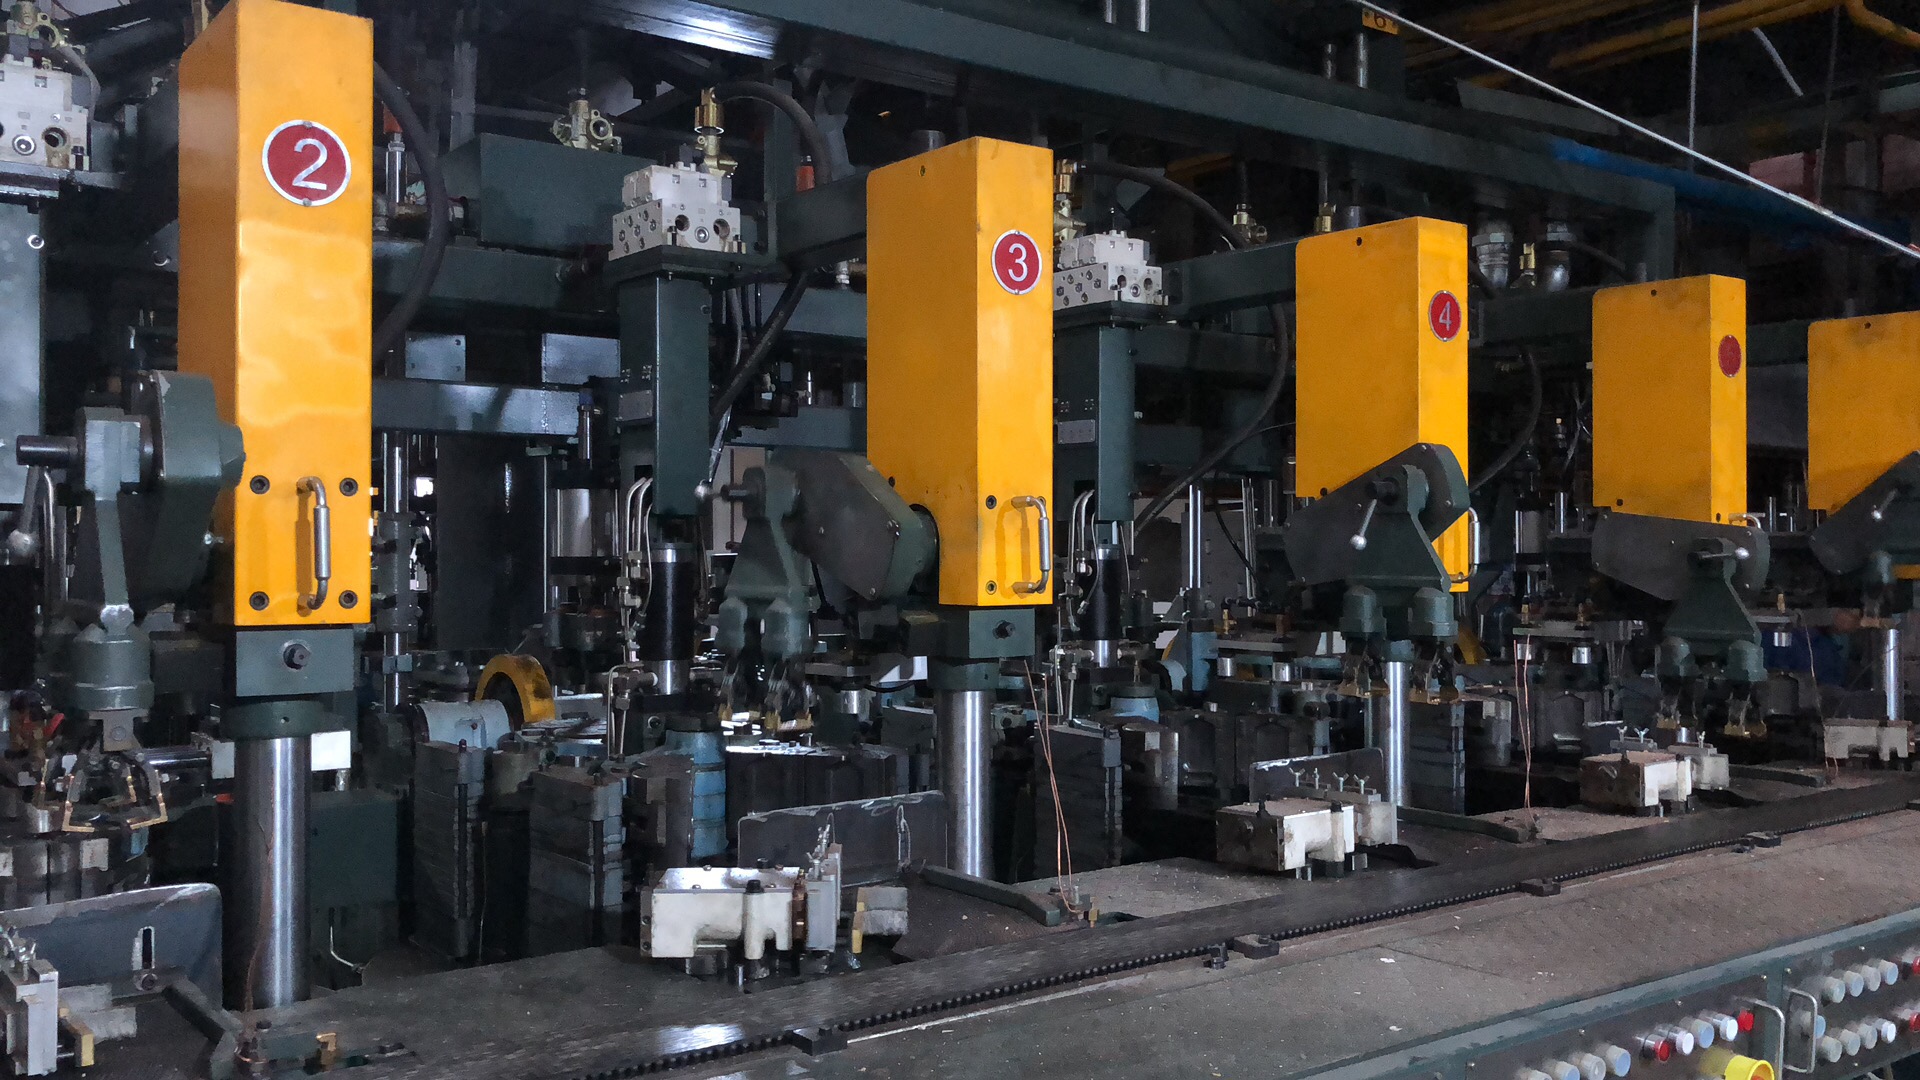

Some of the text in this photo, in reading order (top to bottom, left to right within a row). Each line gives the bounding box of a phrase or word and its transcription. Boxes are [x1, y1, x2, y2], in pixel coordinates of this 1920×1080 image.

[292, 138, 328, 190] 2
[1008, 243, 1028, 282] 3
[1439, 301, 1452, 331] 4
